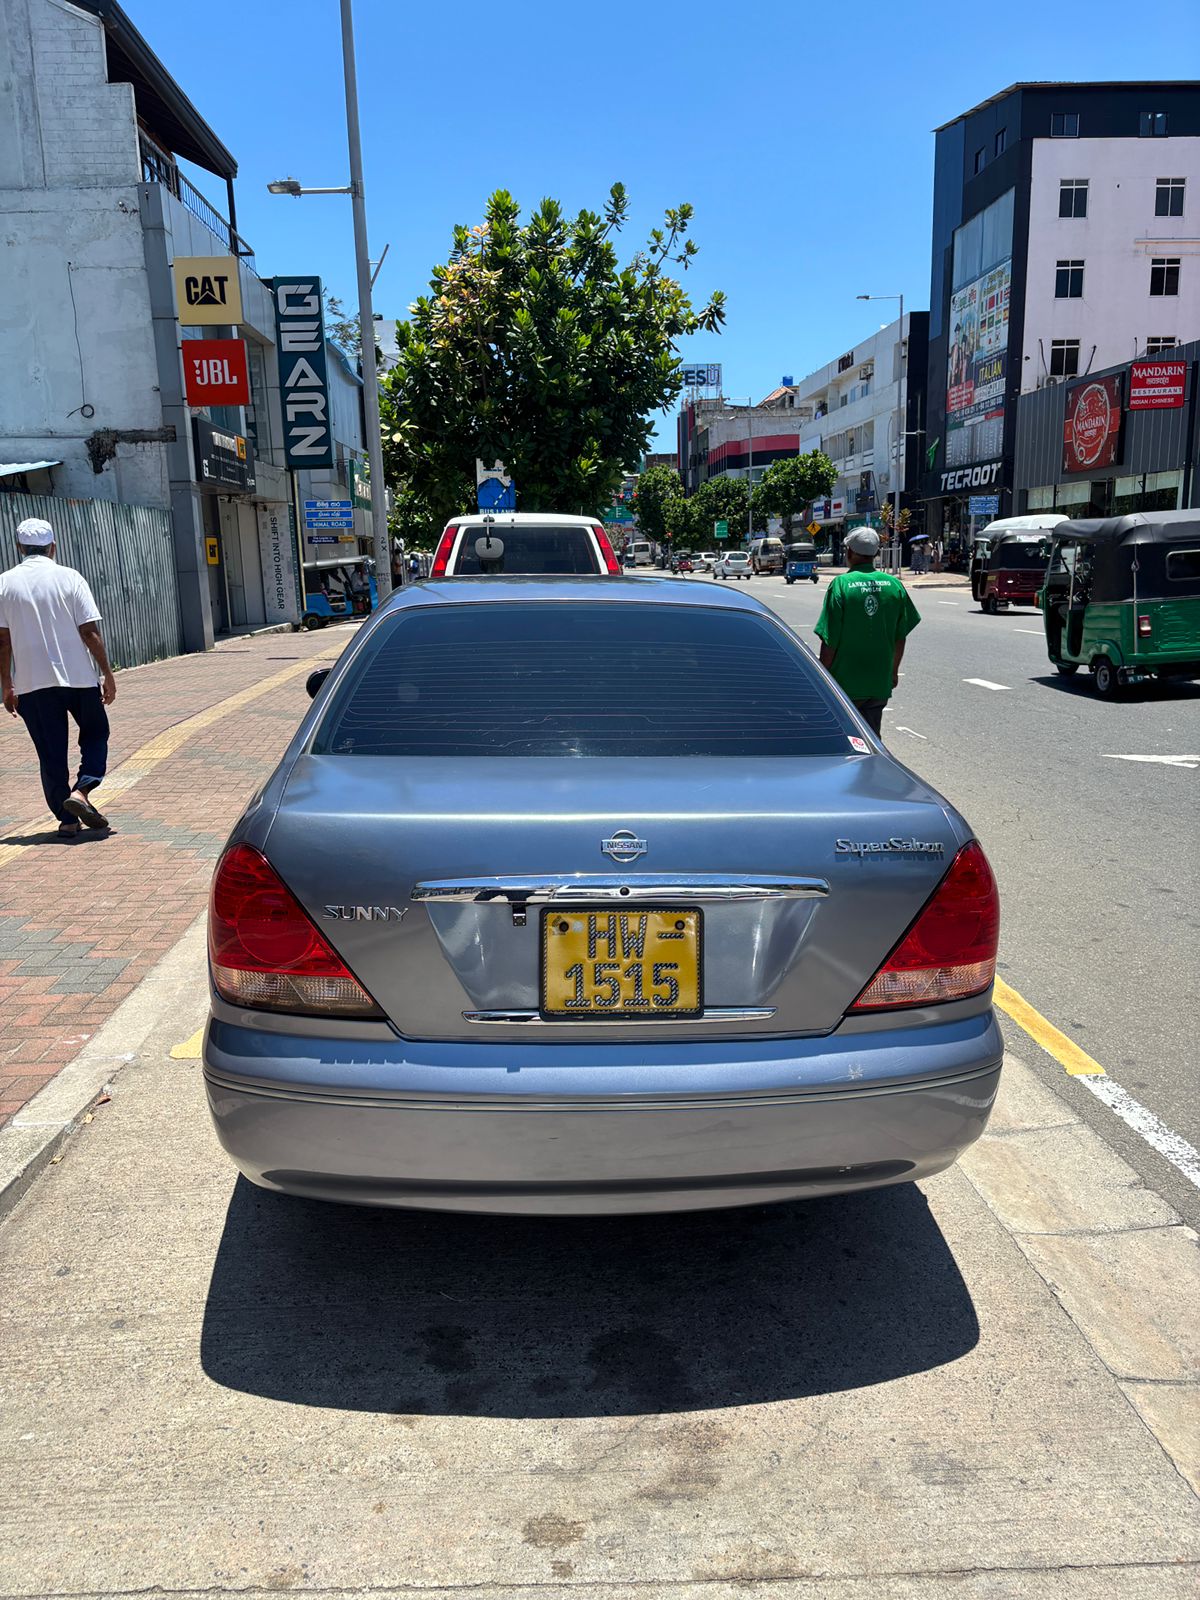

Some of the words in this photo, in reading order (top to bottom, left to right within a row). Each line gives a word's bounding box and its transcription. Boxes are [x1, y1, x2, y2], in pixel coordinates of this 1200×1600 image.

[185, 276, 228, 305] CAT
[193, 360, 238, 385] JBL
[277, 285, 329, 456] GEARZ
[1132, 366, 1184, 378] MANDARIN
[1077, 415, 1106, 432] MANDARIN
[940, 462, 1002, 491] TECROOT
[270, 517, 279, 540] SHIFT
[272, 543, 280, 563] INTO
[274, 565, 282, 585] HIGH
[276, 587, 285, 610] GEAR
[607, 841, 643, 849] NISSAN
[322, 905, 409, 921] SUNNY
[565, 963, 679, 1007] 1515
